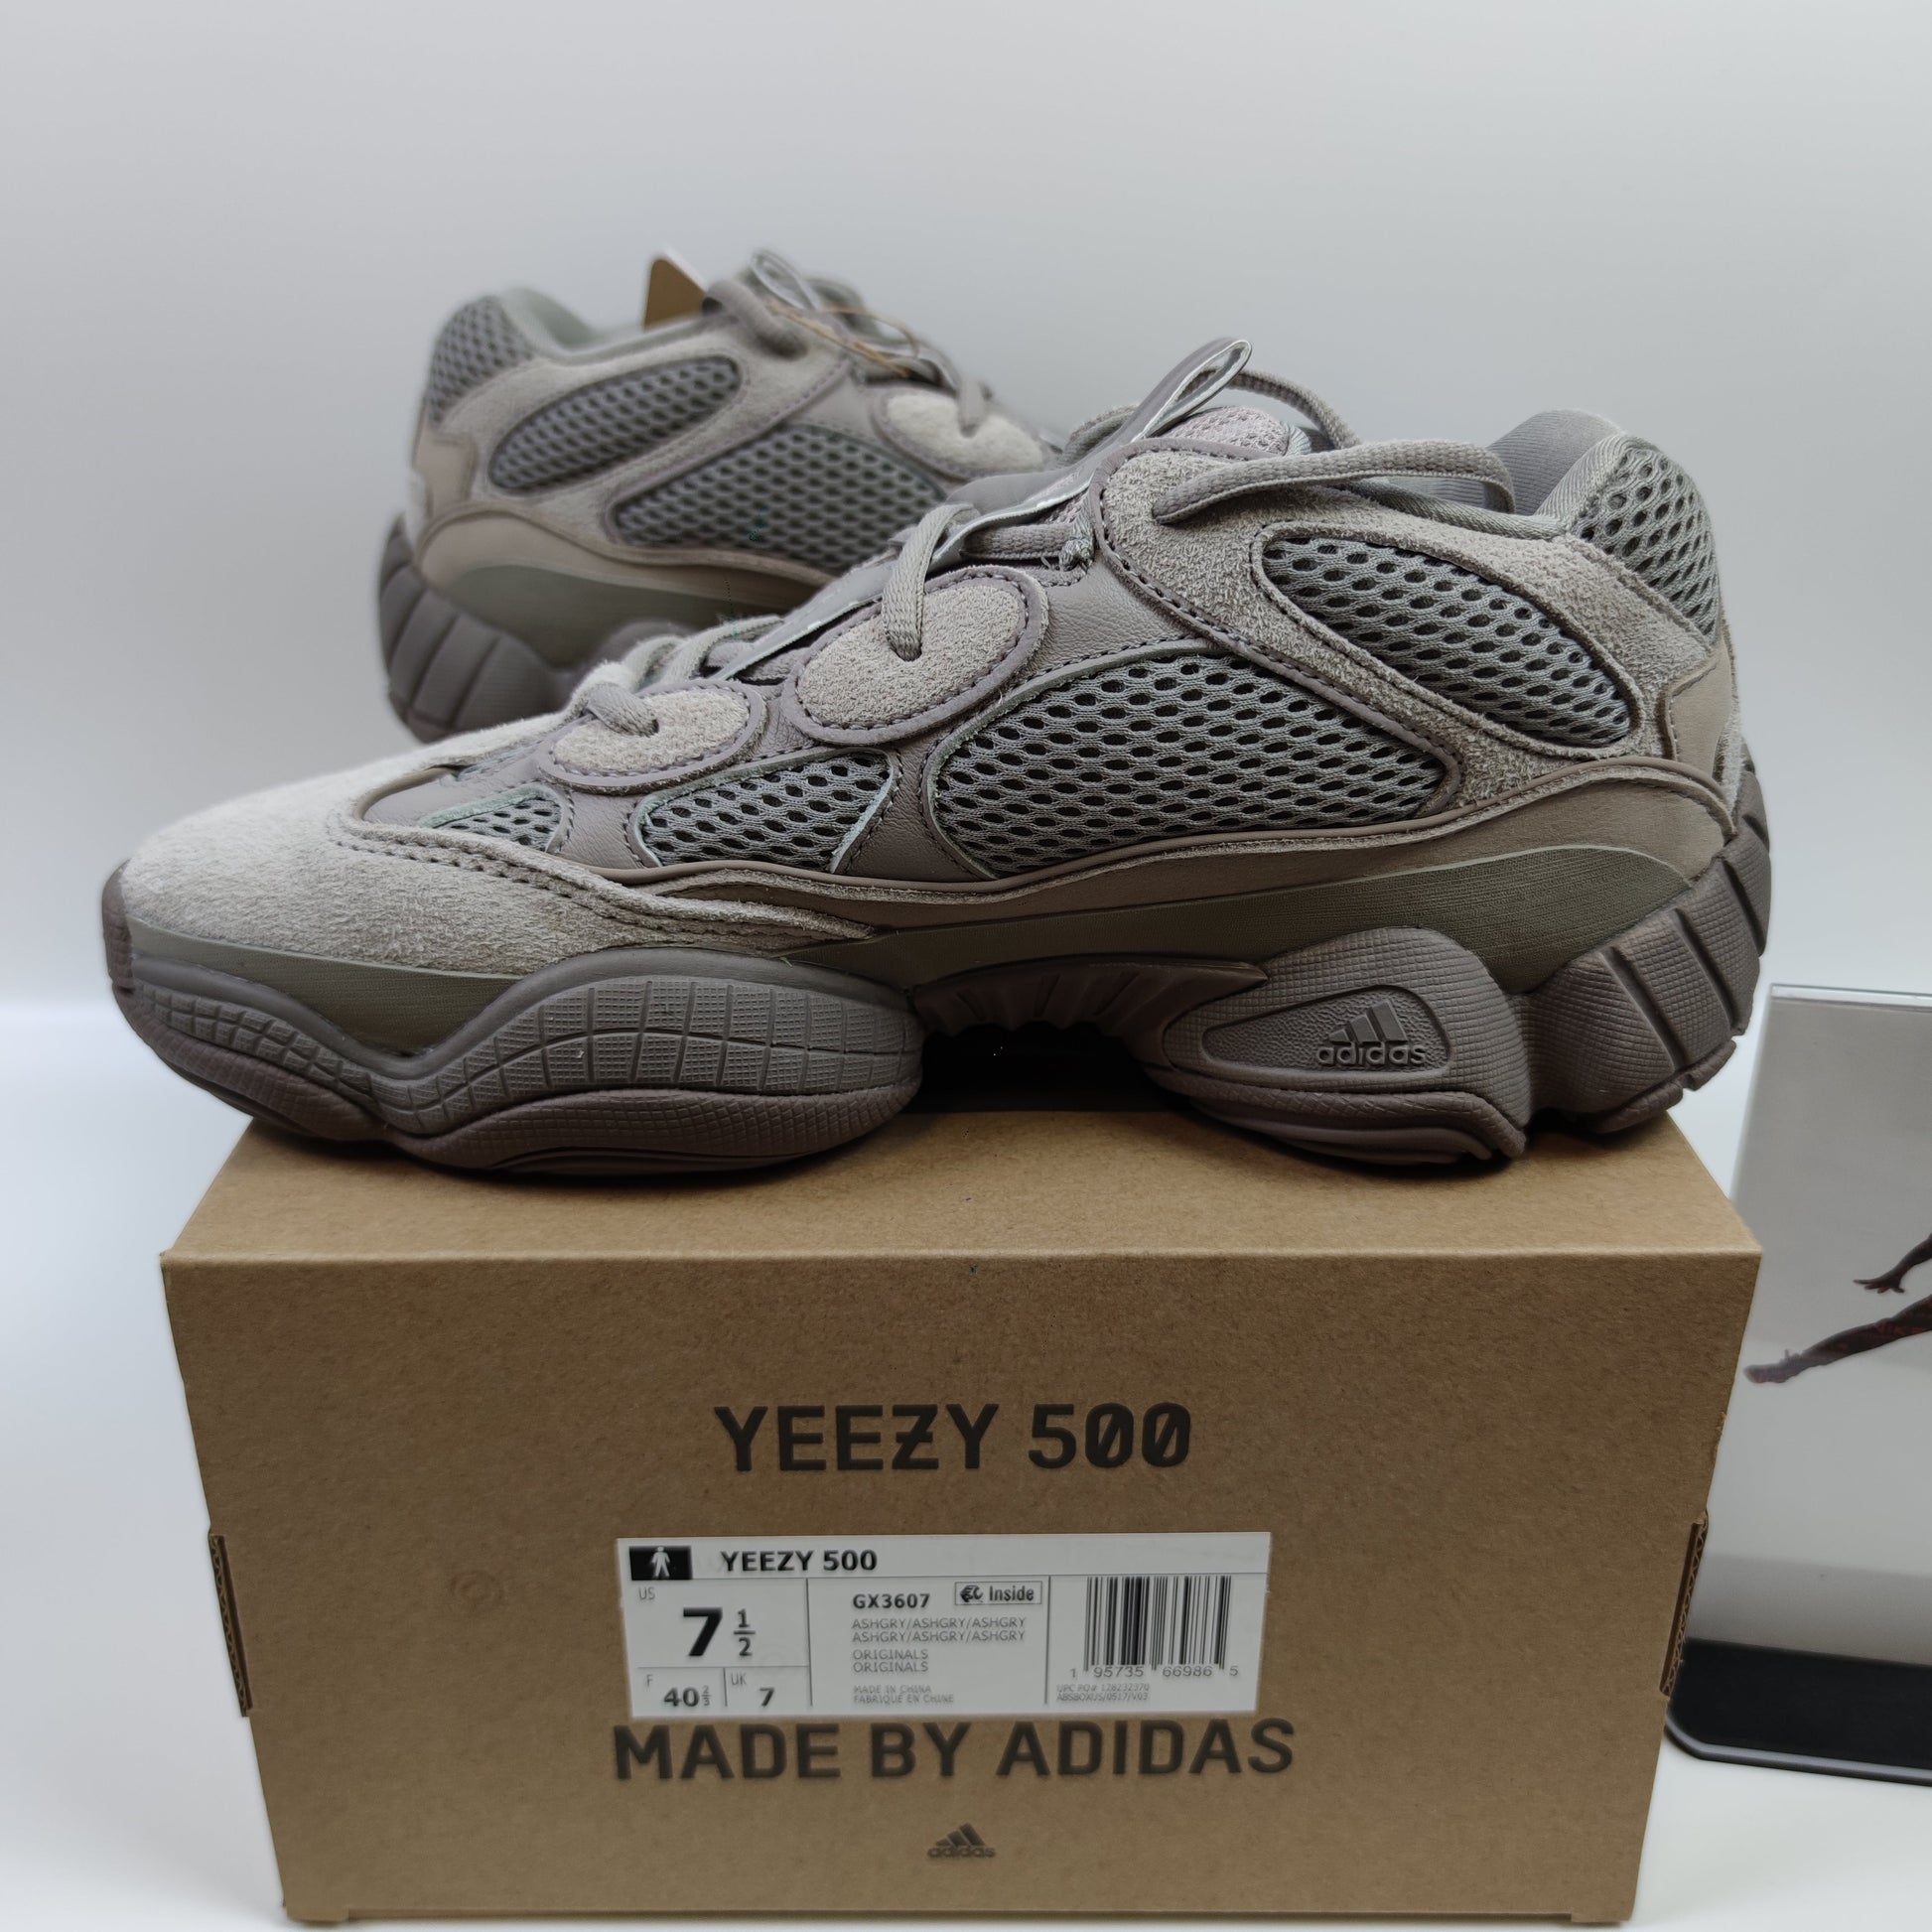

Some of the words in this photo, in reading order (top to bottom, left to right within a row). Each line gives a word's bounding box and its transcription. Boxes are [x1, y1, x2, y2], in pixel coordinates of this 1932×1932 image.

[1316, 1042, 1427, 1065] adidas
[714, 1403, 999, 1471] YEEZY
[1029, 1402, 1192, 1469] 500
[721, 1550, 813, 1572] YEEZY
[823, 1549, 877, 1572] 500
[638, 1587, 655, 1599] US
[852, 1592, 930, 1609] GX3607
[989, 1585, 1035, 1601] Inside
[851, 1616, 1027, 1630] ASHGRY/ASHGRY/ASHGRY
[683, 1607, 723, 1656] 7
[852, 1629, 1027, 1643] ASHGRY/ASHGRY/ASHGRY
[853, 1648, 929, 1661] ORIGINALS
[853, 1661, 929, 1673] ORIGINALS
[1093, 1666, 1144, 1678] 95735
[1162, 1665, 1212, 1677] 66986
[1229, 1664, 1238, 1676] 5
[731, 1673, 747, 1685] UK
[663, 1687, 700, 1707] 40
[759, 1688, 774, 1707] 7
[614, 1724, 841, 1779] MADE
[870, 1722, 971, 1777] BY
[996, 1719, 1296, 1777] ADIDAS
[926, 1844, 996, 1860] adidas
